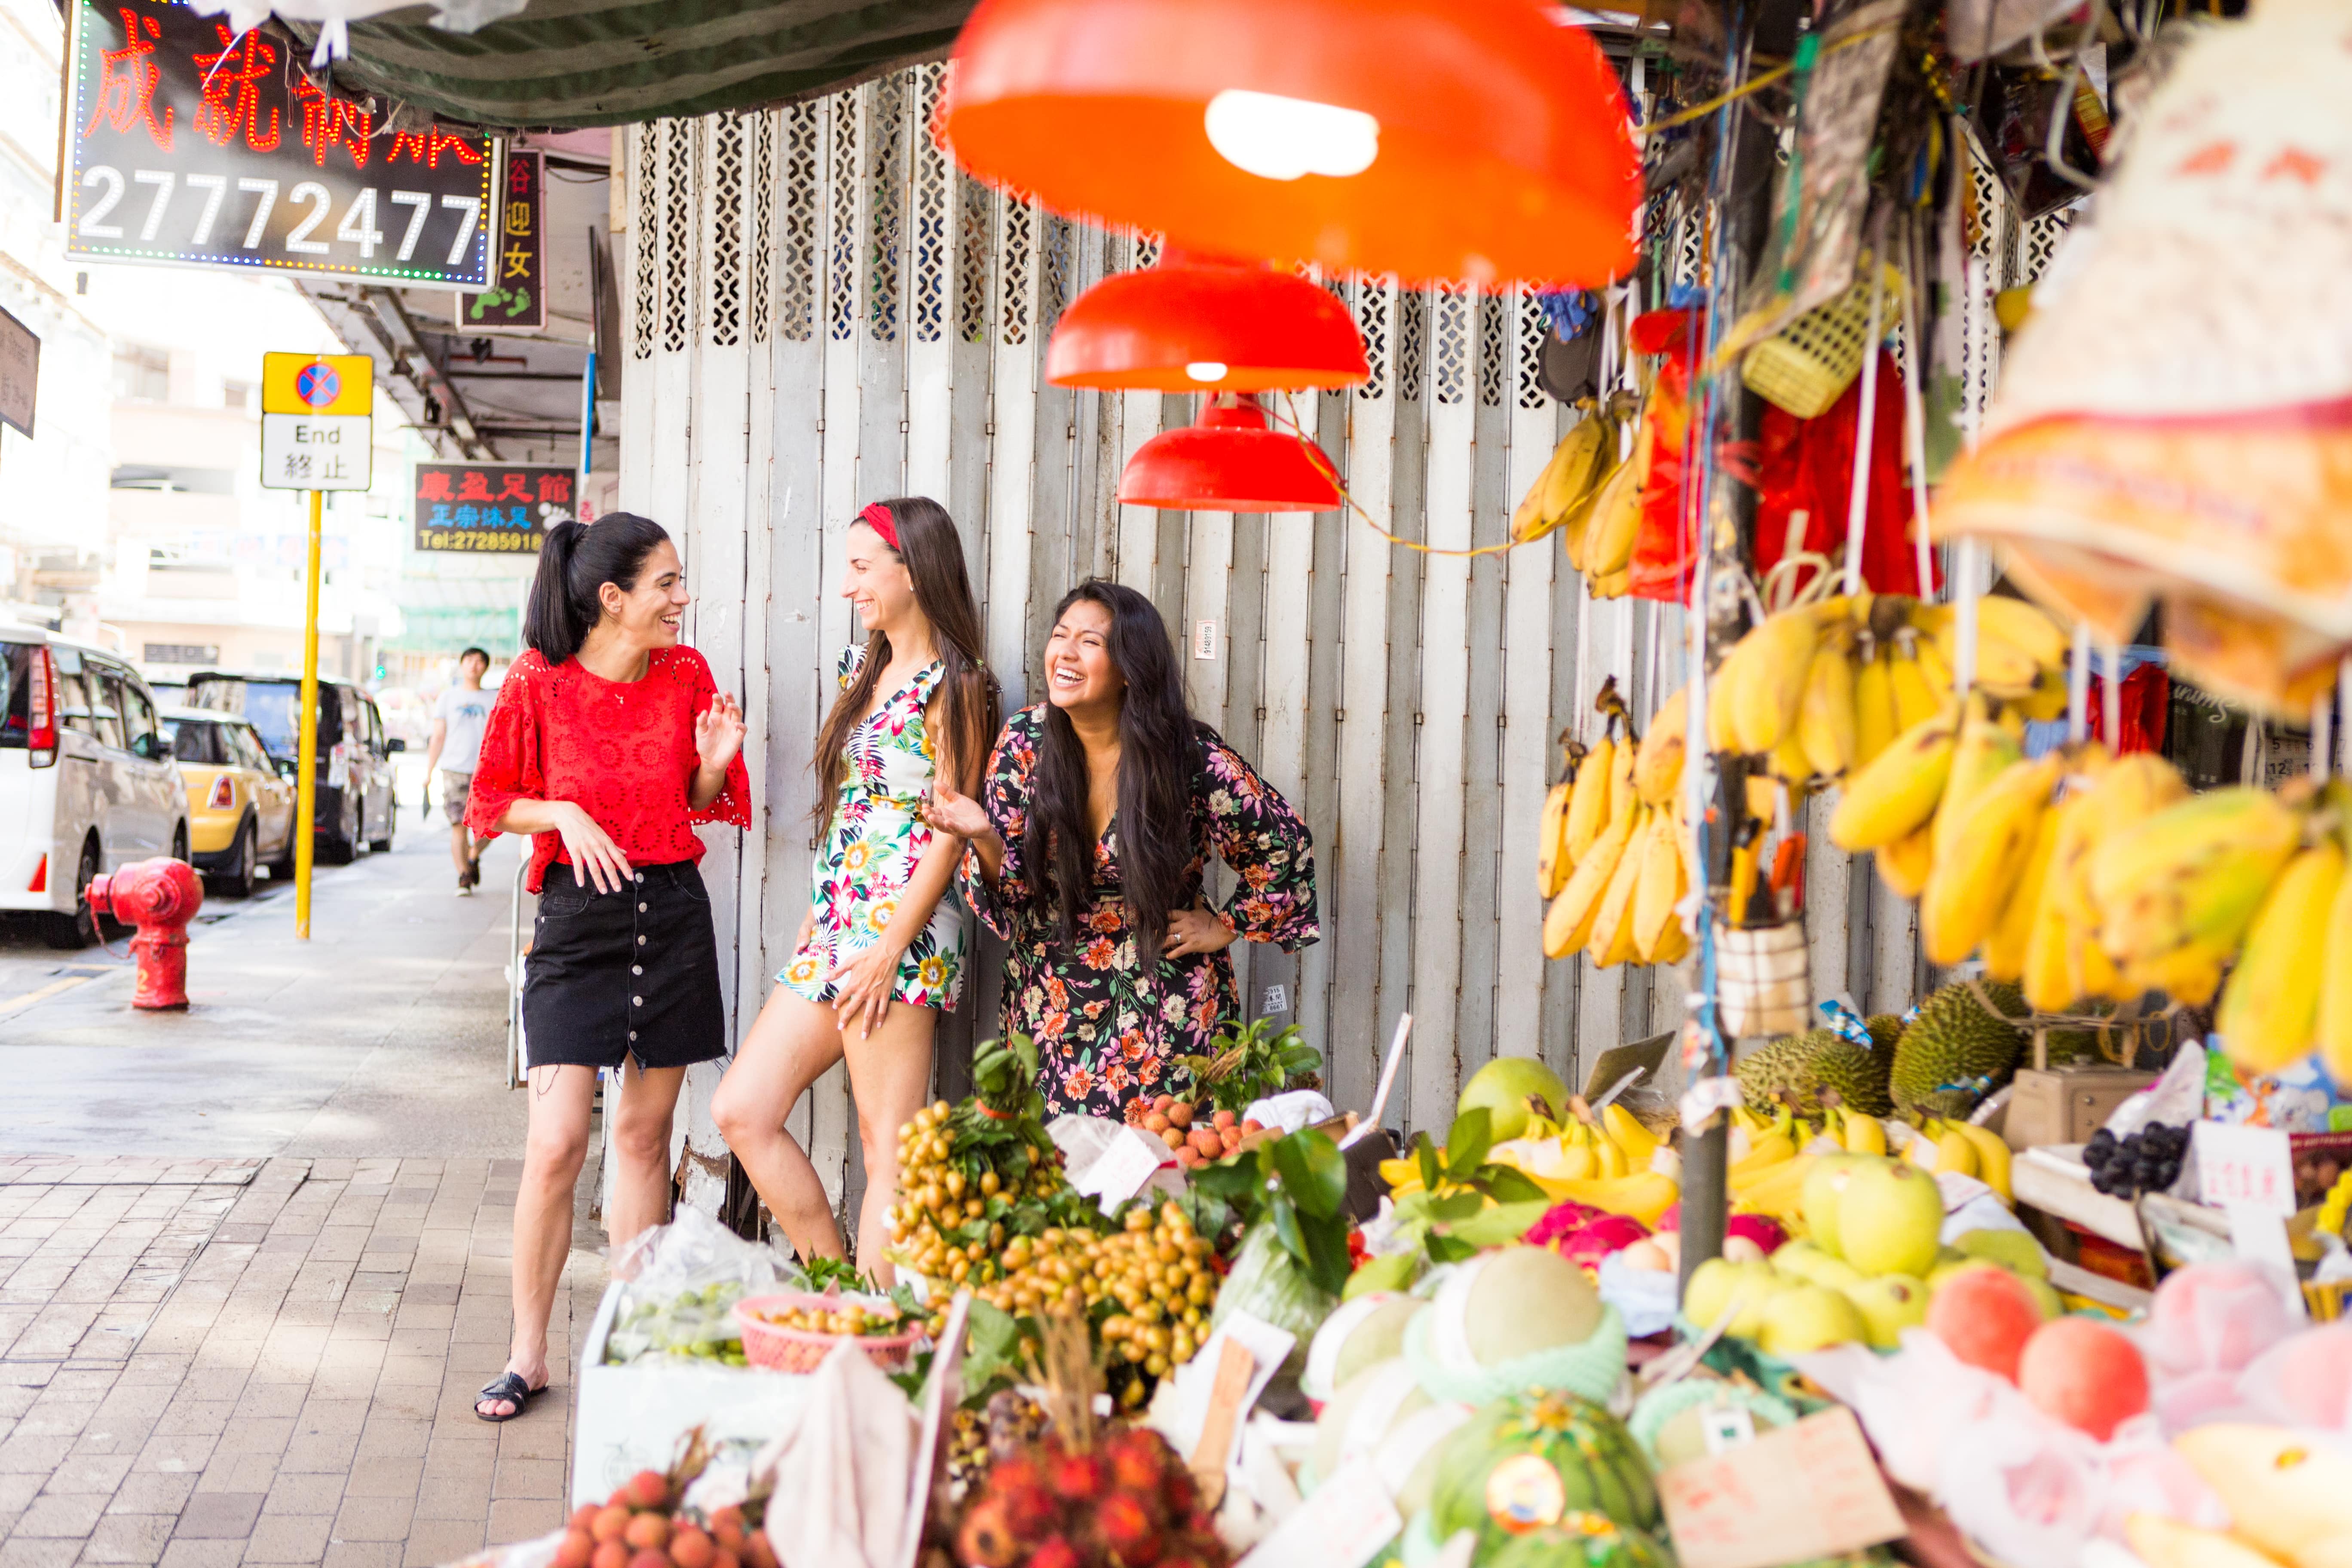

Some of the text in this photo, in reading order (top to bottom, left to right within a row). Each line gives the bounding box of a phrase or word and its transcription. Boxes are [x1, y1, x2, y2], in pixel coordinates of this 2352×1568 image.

[78, 165, 482, 266] 27772477
[296, 425, 340, 444] End
[285, 453, 349, 479] 終止
